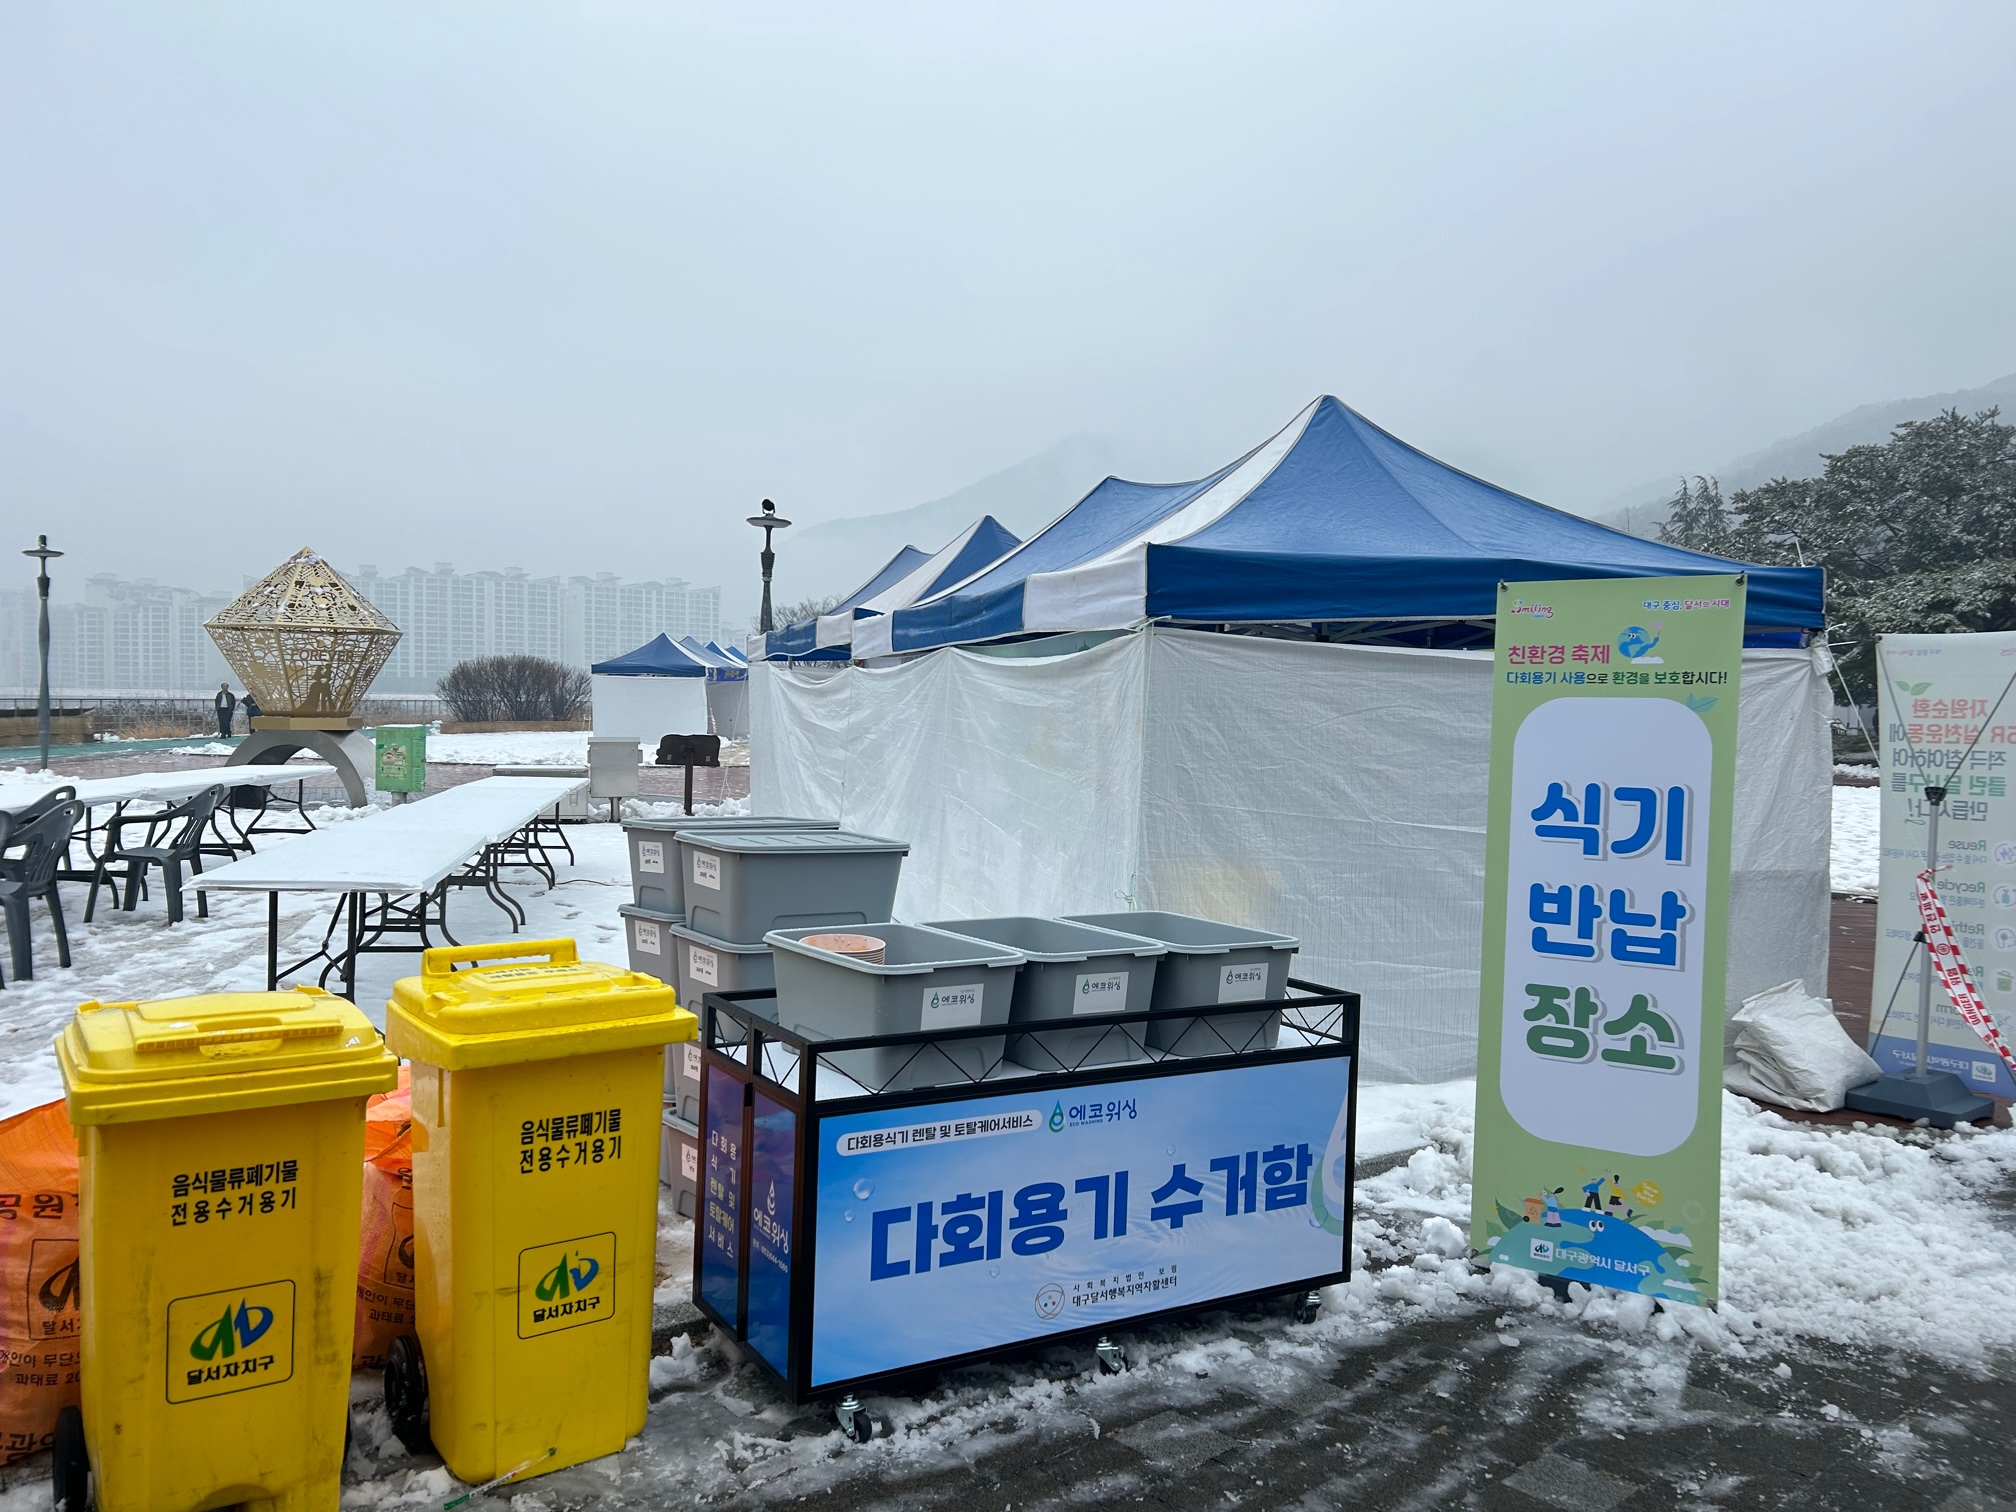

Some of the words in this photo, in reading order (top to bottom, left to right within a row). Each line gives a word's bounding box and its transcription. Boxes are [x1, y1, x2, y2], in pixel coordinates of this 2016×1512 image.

[1643, 601, 1660, 610] 대구
[1663, 600, 1682, 611] 중심,
[1684, 600, 1709, 610] 달서의
[1712, 599, 1730, 608] 시대
[291, 650, 354, 662] FOREVER
[1508, 644, 1566, 665] 친환경
[1571, 644, 1611, 664] 축제
[1506, 671, 1556, 685] 다회용기
[1560, 671, 1608, 685] 사용으로
[1612, 671, 1649, 685] 환경을
[1654, 670, 1727, 685] 보호합시다!
[1530, 781, 1686, 862] 식기
[1528, 882, 1687, 966] 반납
[941, 993, 975, 1004] 에코위싱
[1957, 993, 1981, 1026] DANGER
[1522, 982, 1678, 1070] 장소
[1069, 1098, 1138, 1123] 에코위싱
[520, 1108, 622, 1146] 음식물류폐기물
[847, 1129, 909, 1151] 다회용식기
[912, 1126, 937, 1142] 렌탈
[939, 1125, 951, 1138] 및
[954, 1115, 1034, 1136] 토탈케어서비스
[519, 1135, 622, 1175] 전용수거용기
[171, 1160, 299, 1198] 음식물류폐기물
[0, 1192, 79, 1220] 공원
[171, 1187, 297, 1227] 전용수거용기
[870, 1170, 1130, 1281] 다회용기
[1150, 1143, 1313, 1230] 수거함
[753, 1206, 789, 1255] 에코위싱
[1555, 1247, 1612, 1270] 대구광역시
[1614, 1259, 1651, 1276] 달서구
[1072, 1275, 1178, 1307] 대구달서행복지역자활센터
[1073, 1271, 1145, 1293] 사회복지법인
[368, 1308, 404, 1324] 과태료
[533, 1296, 601, 1323] 달서자치구
[15, 1372, 59, 1387] 과태료
[186, 1355, 275, 1386] 달서자치구
